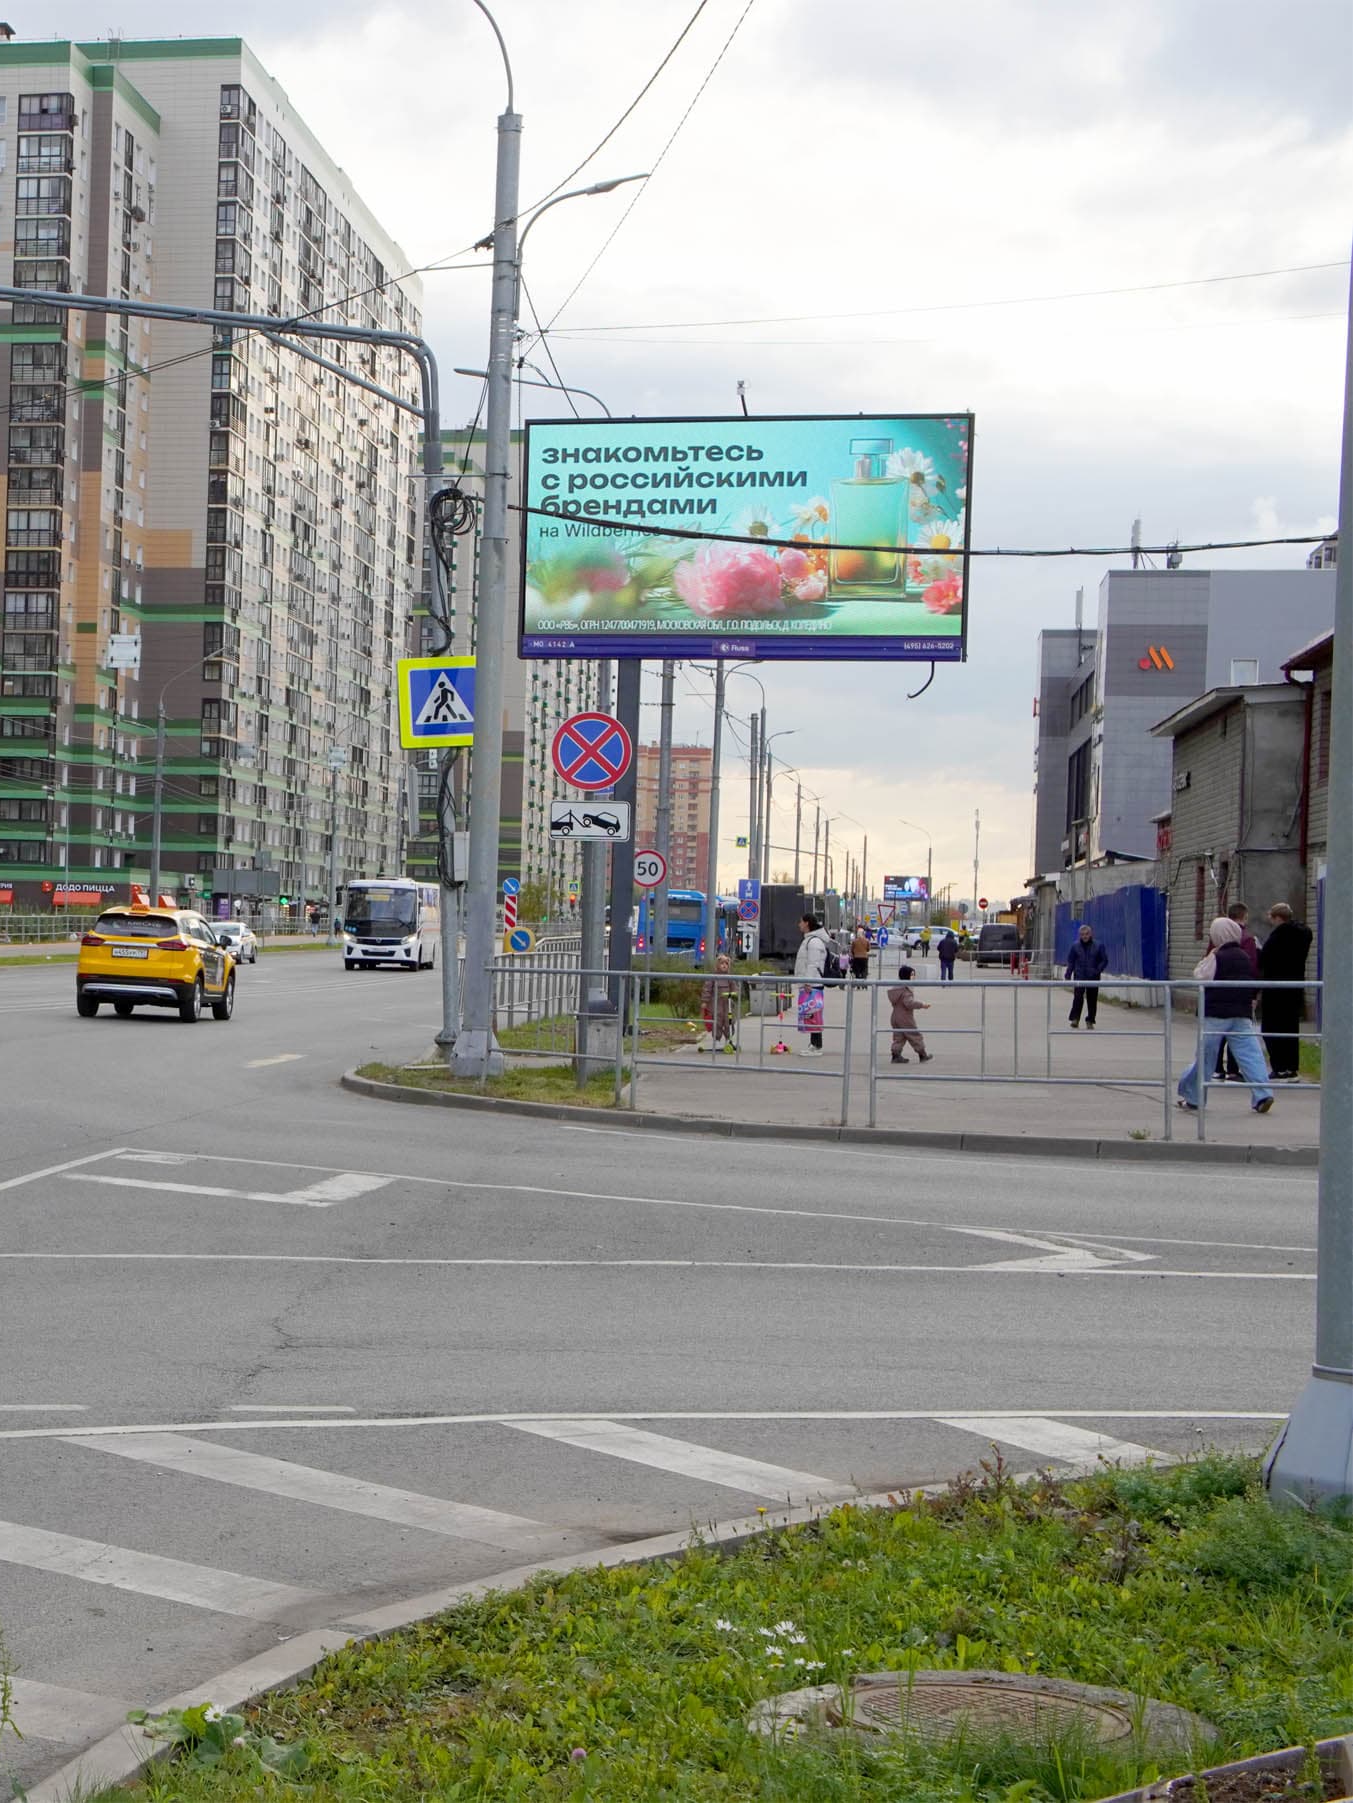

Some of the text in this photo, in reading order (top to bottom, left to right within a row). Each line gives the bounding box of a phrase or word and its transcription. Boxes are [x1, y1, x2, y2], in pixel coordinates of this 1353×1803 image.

[541, 444, 764, 464] знакомьтесь
[541, 465, 807, 494] с российскими
[540, 494, 717, 519] брендами
[539, 526, 559, 537] на
[537, 619, 555, 630] ООО
[580, 619, 600, 630] ОГРН
[637, 861, 659, 876] 50
[55, 883, 115, 894] ДОДО ПИЦЦА
